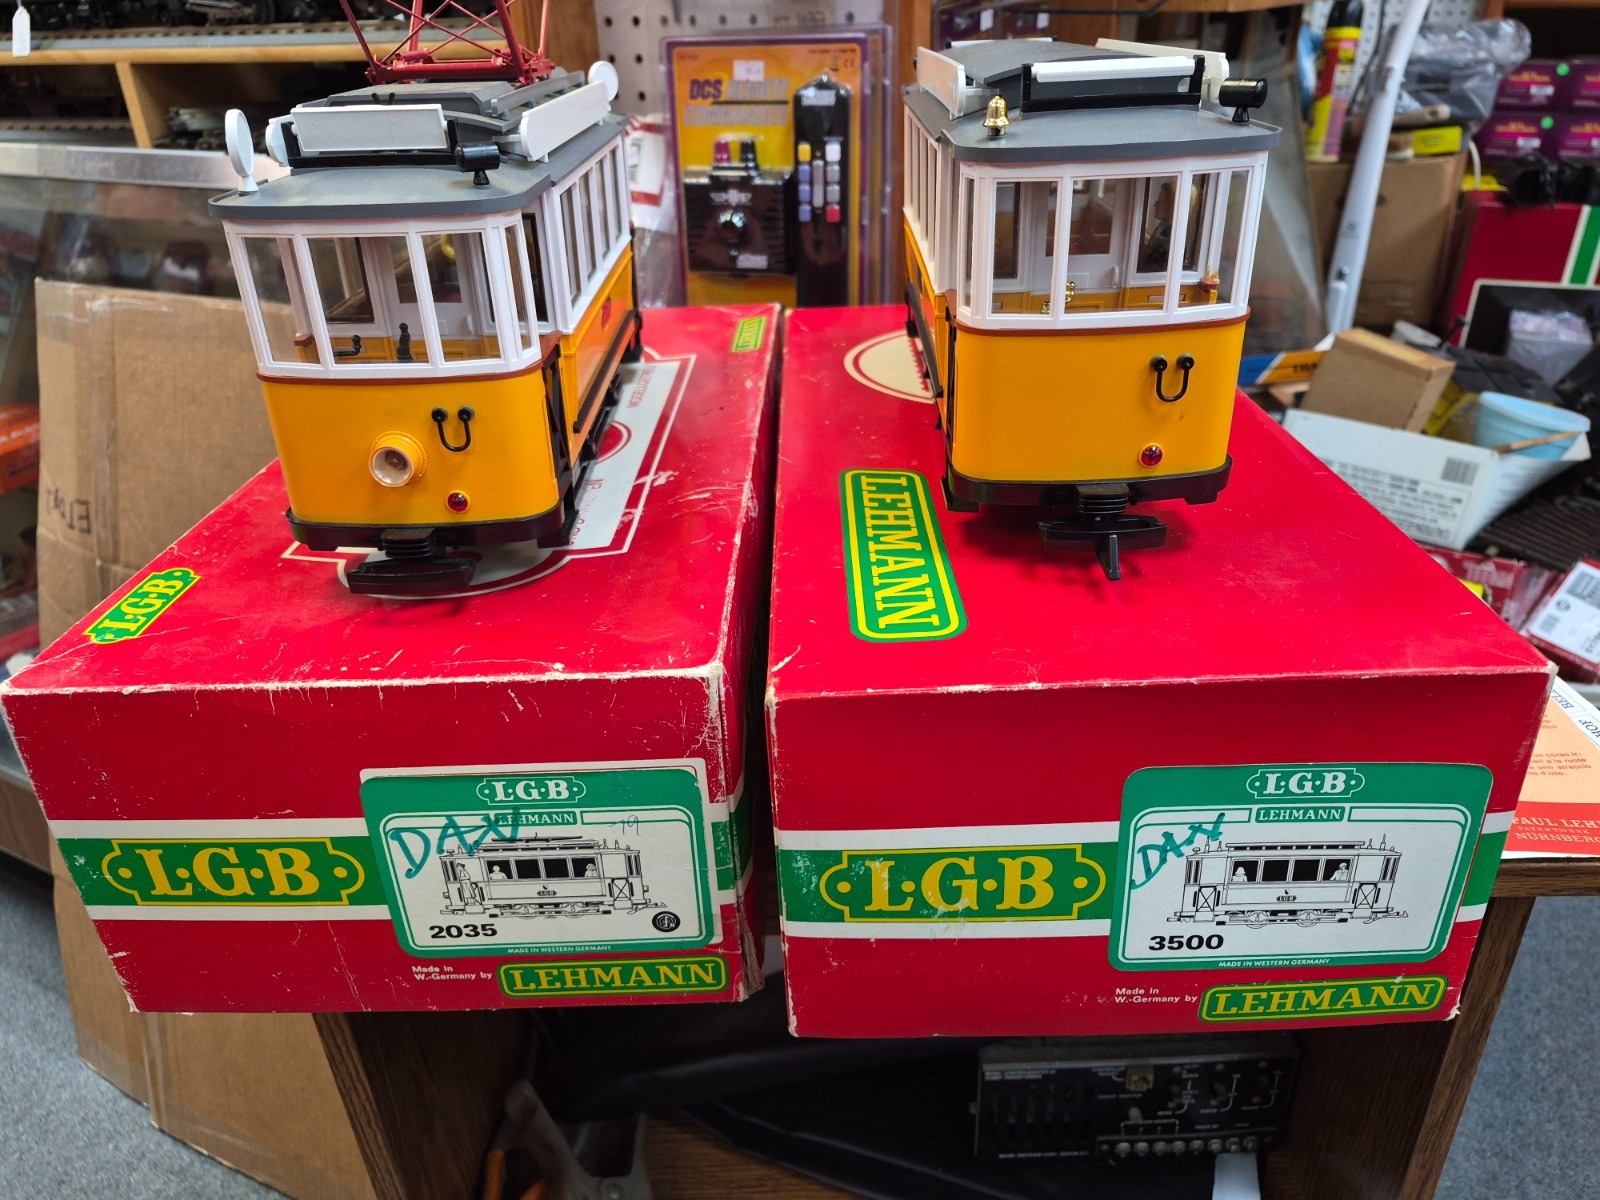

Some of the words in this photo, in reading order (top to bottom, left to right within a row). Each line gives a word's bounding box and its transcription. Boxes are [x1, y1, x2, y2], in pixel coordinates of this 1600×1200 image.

[689, 78, 723, 100] DCS
[684, 105, 788, 127] COMMANDER
[860, 475, 940, 629] LEHMANN
[499, 813, 576, 825] LEHMANN
[1259, 809, 1342, 821] LEHMANN
[1512, 816, 1558, 827] PAUL
[1559, 818, 1600, 829] LEH
[429, 923, 498, 939] 2035
[1148, 934, 1224, 951] 3500
[411, 965, 440, 973] Made
[414, 973, 476, 981] W.-Germany
[479, 971, 493, 980] by
[508, 961, 718, 991] LEHMANN
[1115, 987, 1145, 995] Made
[1149, 987, 1160, 995] in
[1115, 995, 1181, 1004] W.-Germany
[1184, 994, 1198, 1003] by
[1210, 983, 1437, 1016] LEHMANN
